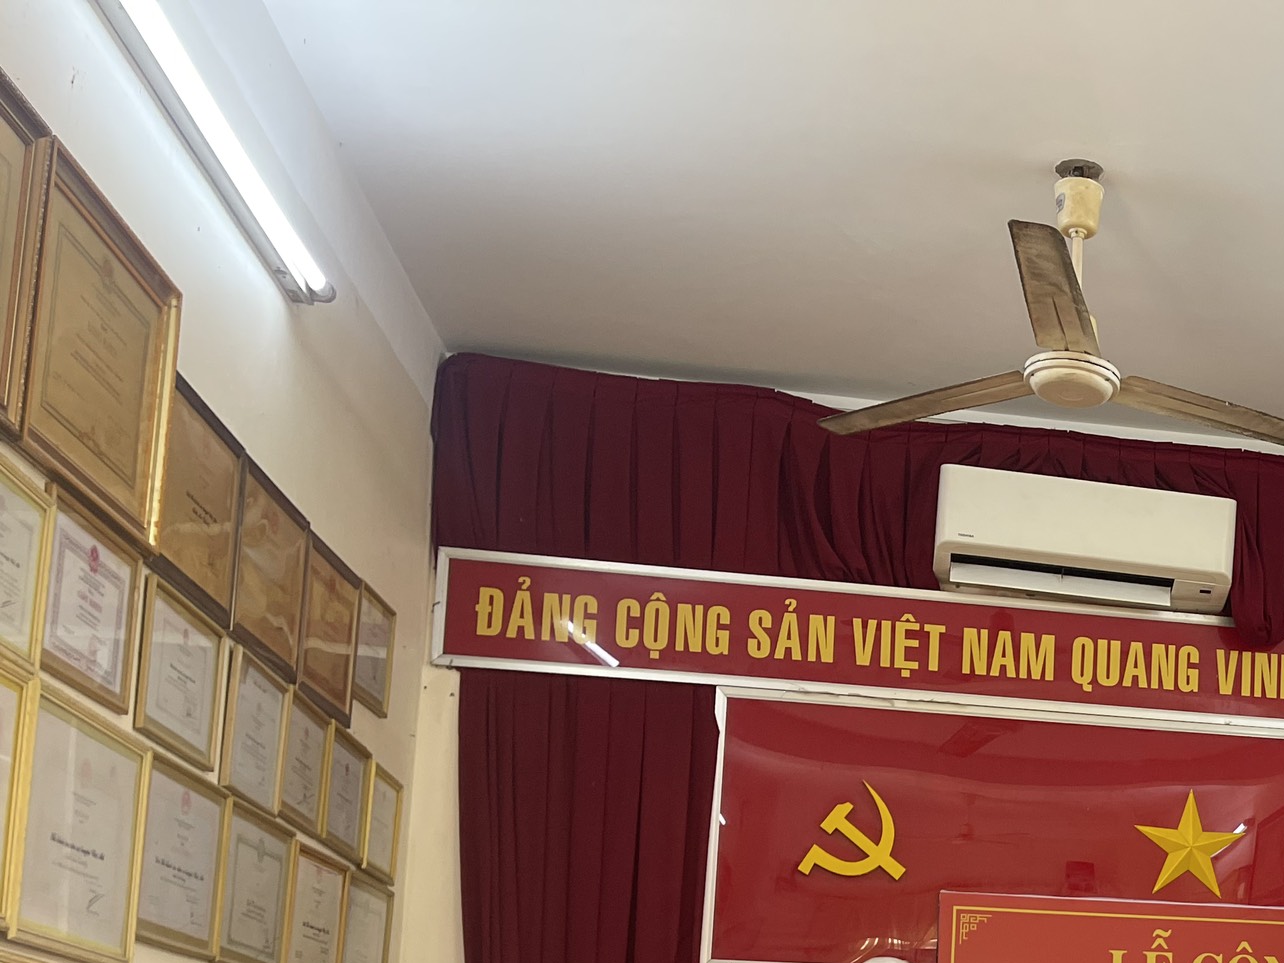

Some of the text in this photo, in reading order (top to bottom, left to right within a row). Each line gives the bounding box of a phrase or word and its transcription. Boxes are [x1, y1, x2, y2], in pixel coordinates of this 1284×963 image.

[475, 577, 598, 645] ĐẢNG
[616, 592, 730, 659] CỘNG
[748, 599, 835, 663] SẢN
[853, 614, 945, 677] VIỆT
[962, 628, 1055, 680] NAM
[1072, 637, 1199, 692] QUANG
